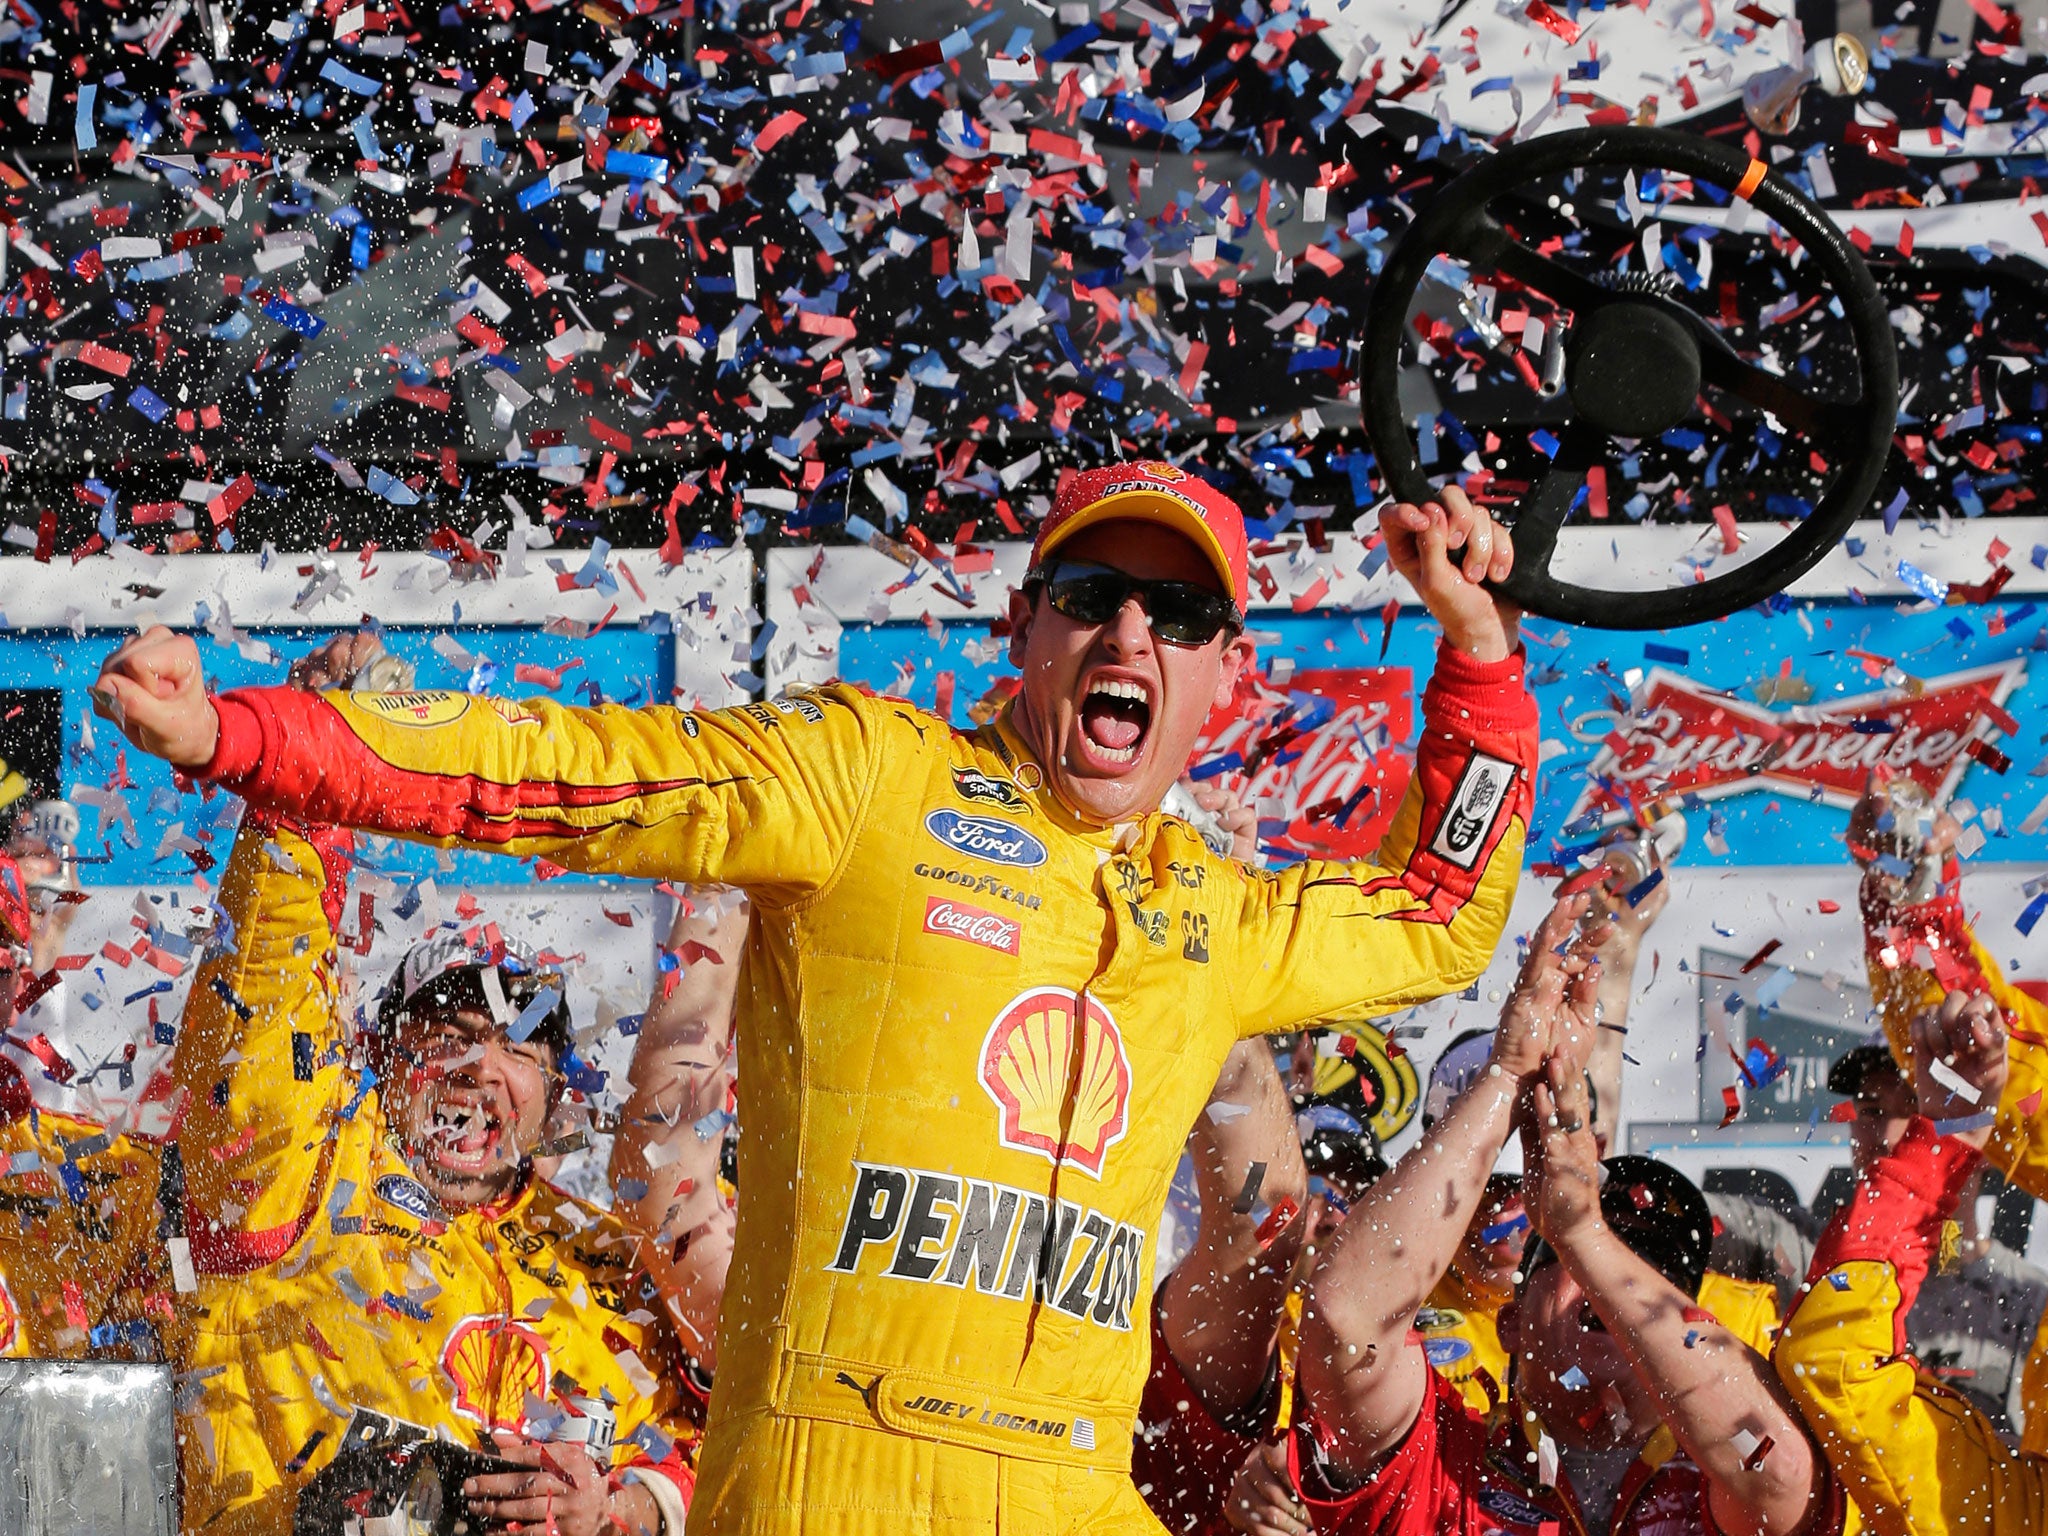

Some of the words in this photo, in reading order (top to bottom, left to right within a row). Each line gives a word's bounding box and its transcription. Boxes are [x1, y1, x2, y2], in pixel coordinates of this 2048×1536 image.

[969, 782, 1005, 801] Sprint
[949, 819, 1025, 858] Ford
[914, 863, 1043, 911] GOODYEAR
[926, 903, 1018, 950] Coca-Cola
[904, 1396, 975, 1419] JOEY
[979, 1410, 1067, 1437] LOGANO
[1489, 1494, 1541, 1522] Ford
